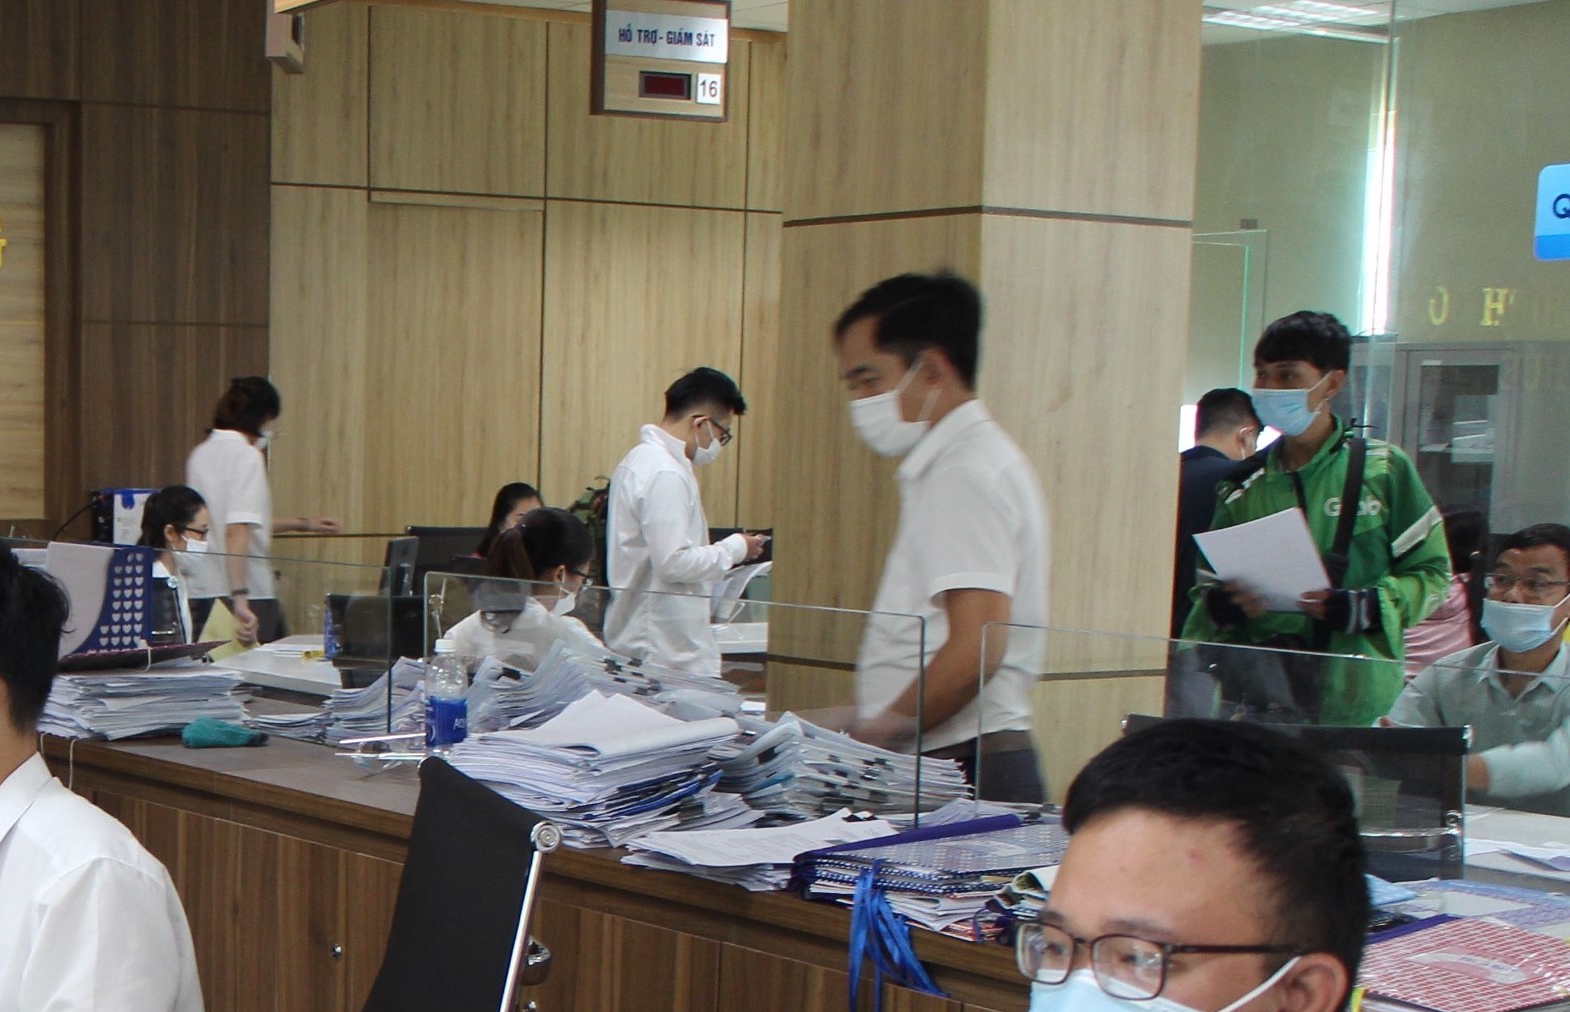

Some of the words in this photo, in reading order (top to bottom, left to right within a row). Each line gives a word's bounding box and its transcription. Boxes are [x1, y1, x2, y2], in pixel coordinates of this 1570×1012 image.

[637, 28, 658, 47] TRỢ
[666, 27, 693, 46] GIÁM
[696, 30, 715, 47] SÁT
[700, 79, 718, 97] 16
[1324, 495, 1382, 517] Gab
